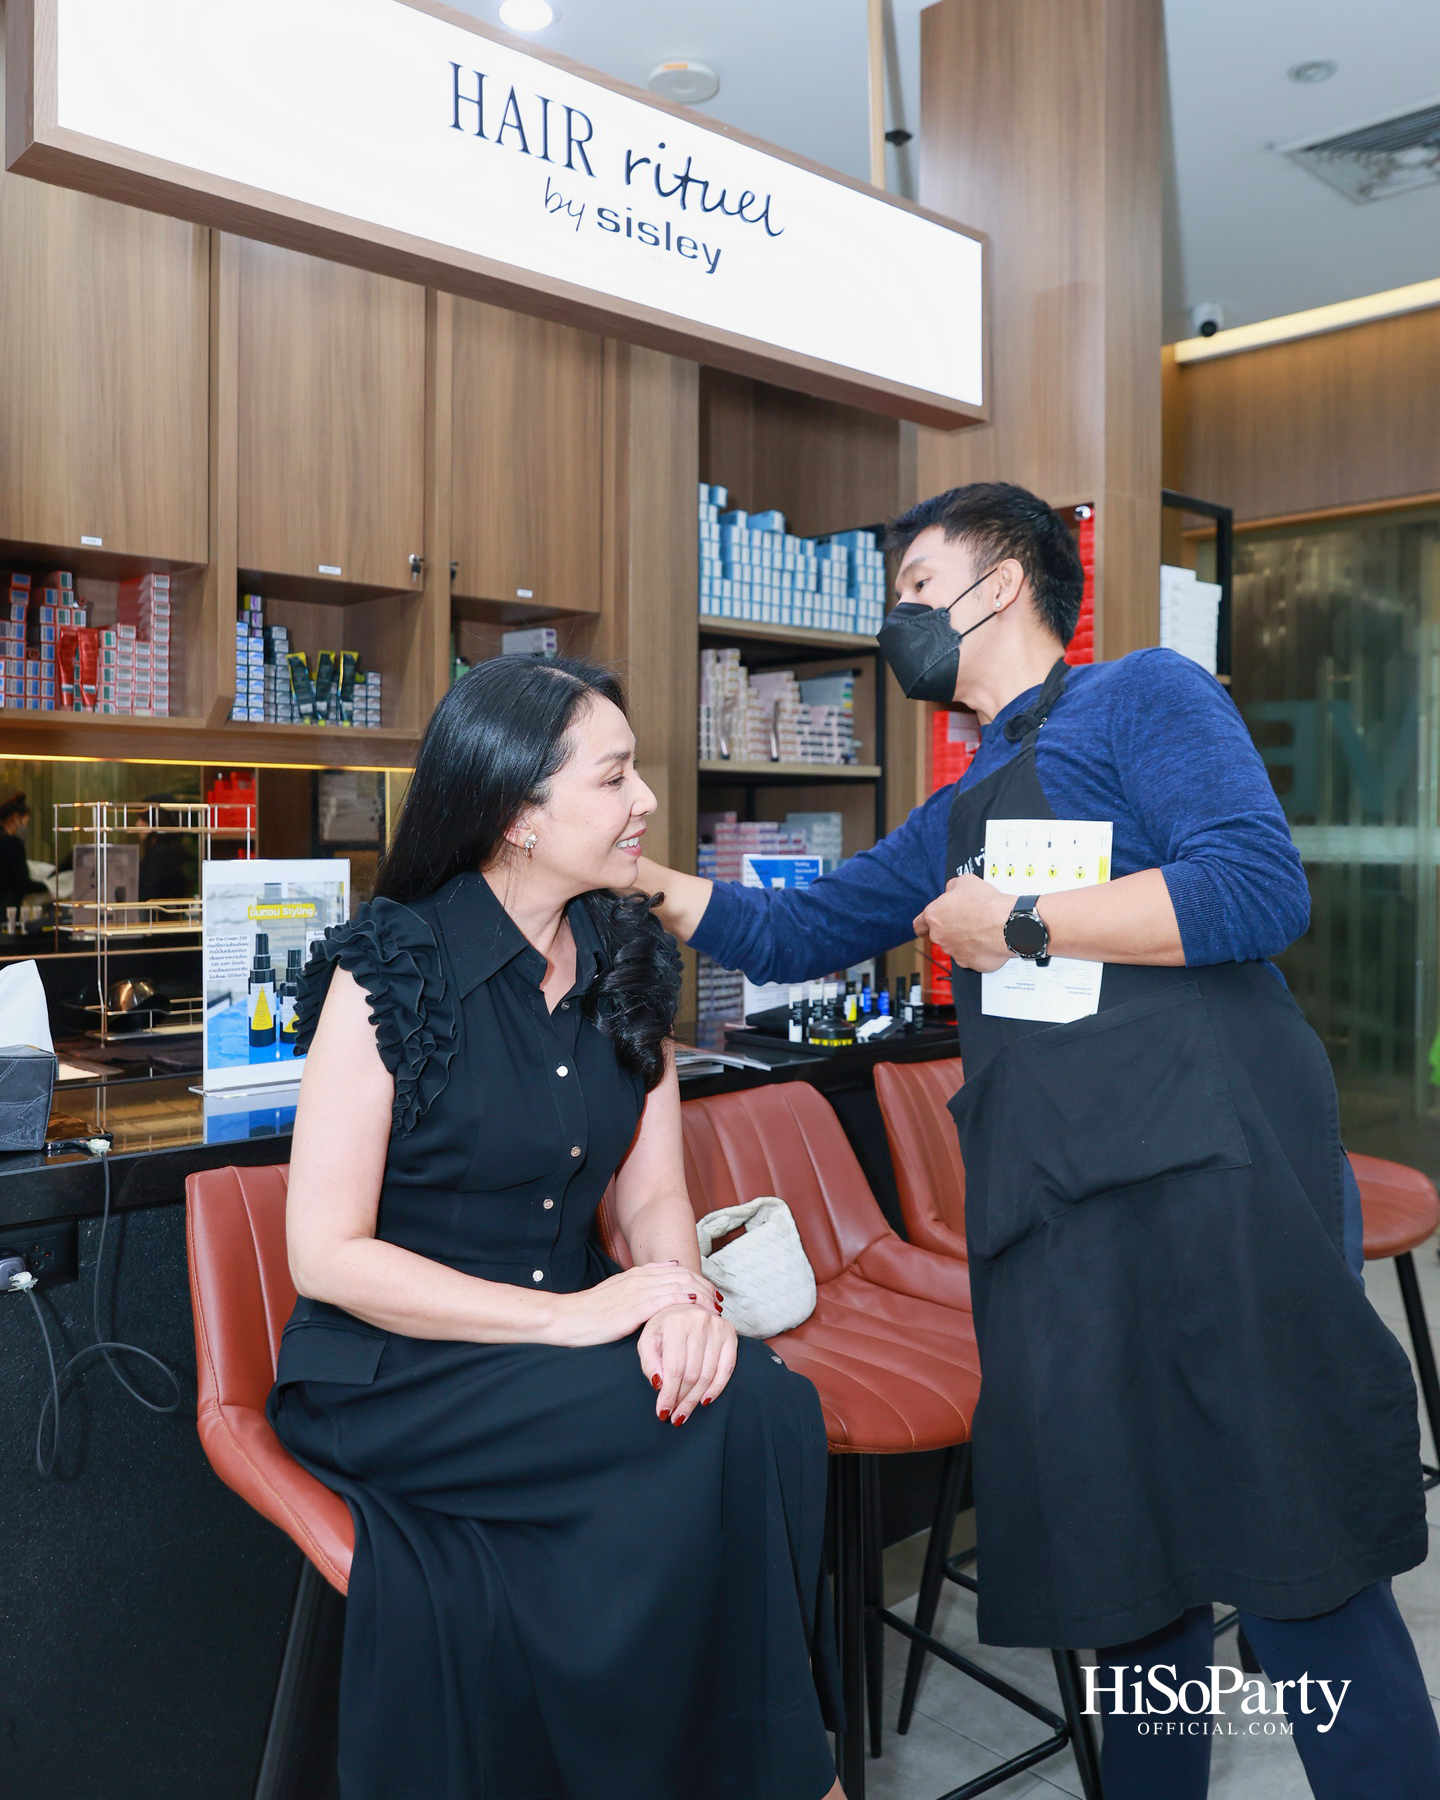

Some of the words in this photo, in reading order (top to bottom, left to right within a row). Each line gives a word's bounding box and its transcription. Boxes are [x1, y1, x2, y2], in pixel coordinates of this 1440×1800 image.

[448, 61, 597, 178] HAIR
[624, 142, 785, 237] rituel
[545, 176, 586, 232] by
[596, 207, 722, 275] sisley
[282, 906, 314, 918] Styling
